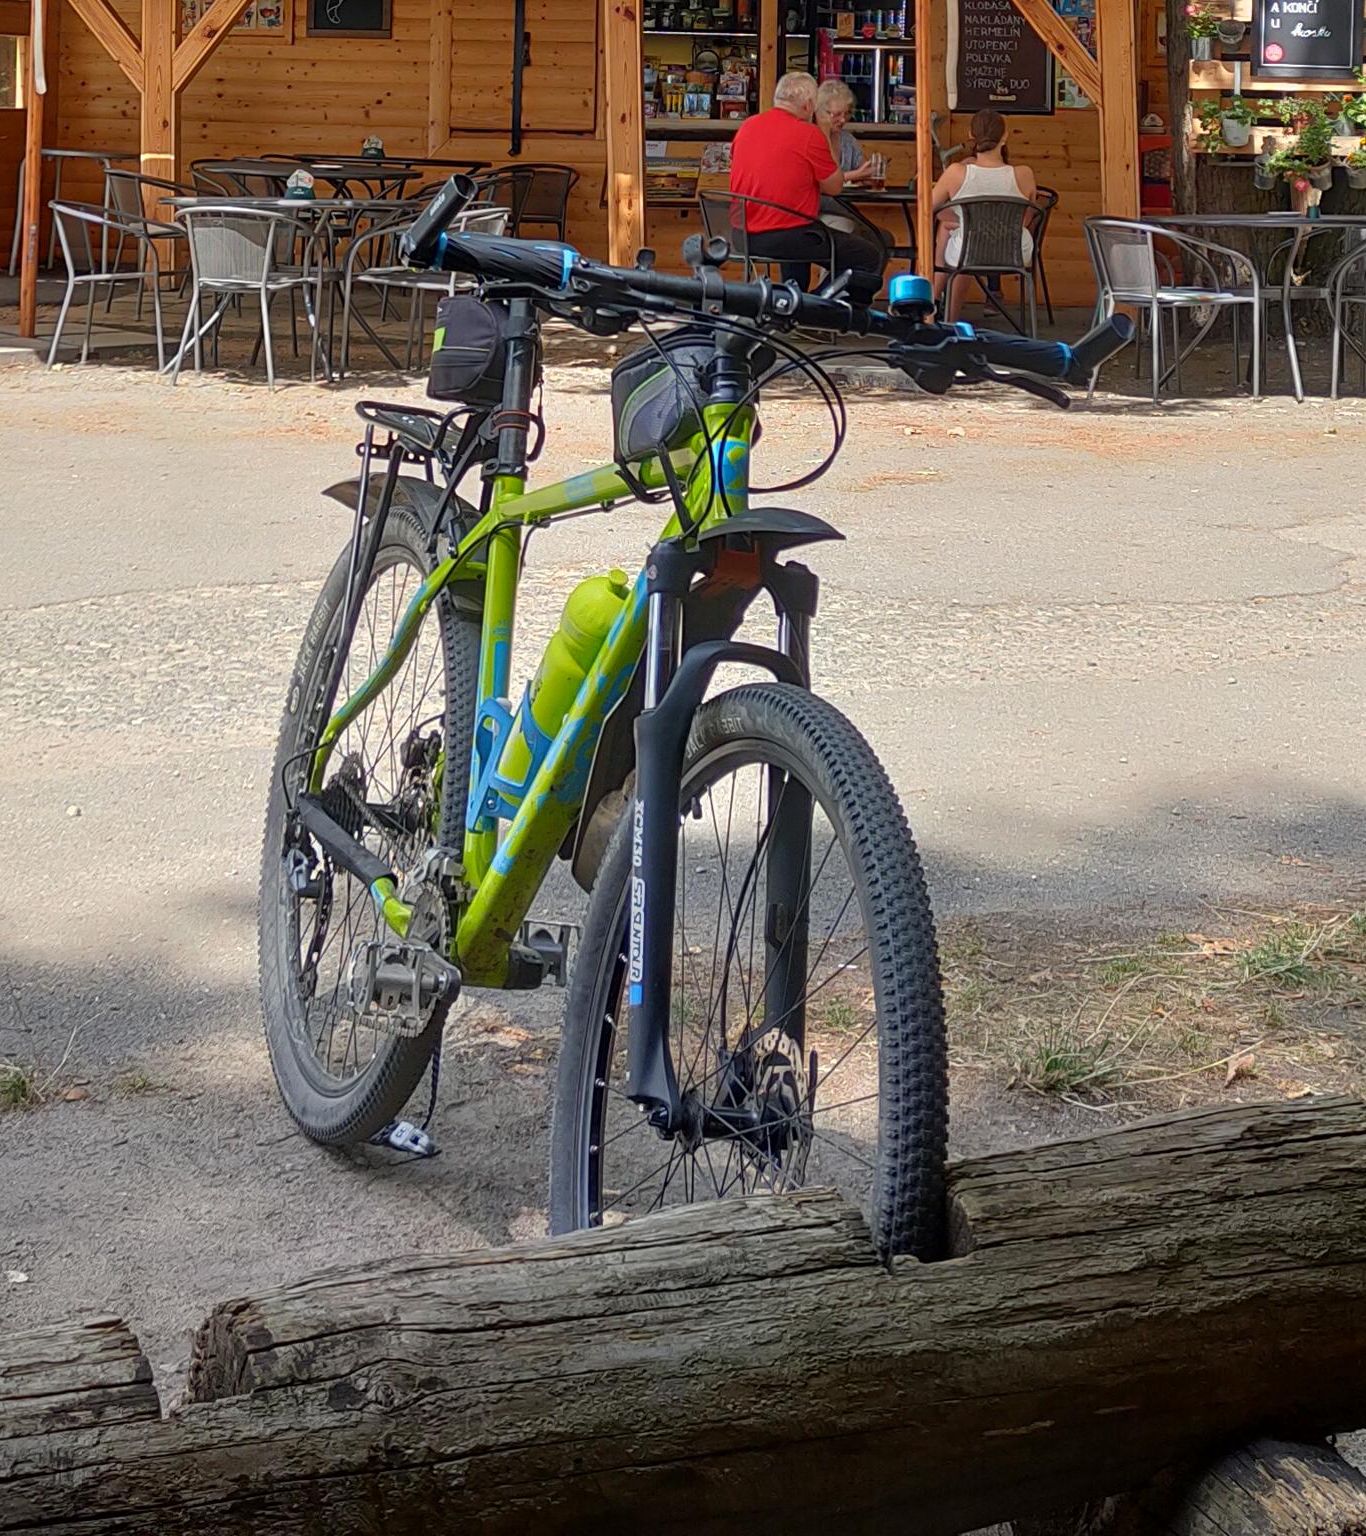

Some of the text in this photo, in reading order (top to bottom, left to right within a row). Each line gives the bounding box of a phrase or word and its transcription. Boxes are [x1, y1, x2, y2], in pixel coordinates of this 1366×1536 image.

[1270, 0, 1320, 14] A KONČÍ
[964, 24, 1021, 38] HERMELÍN
[965, 39, 1018, 51] UTOPENCI
[1010, 78, 1031, 90] DUO
